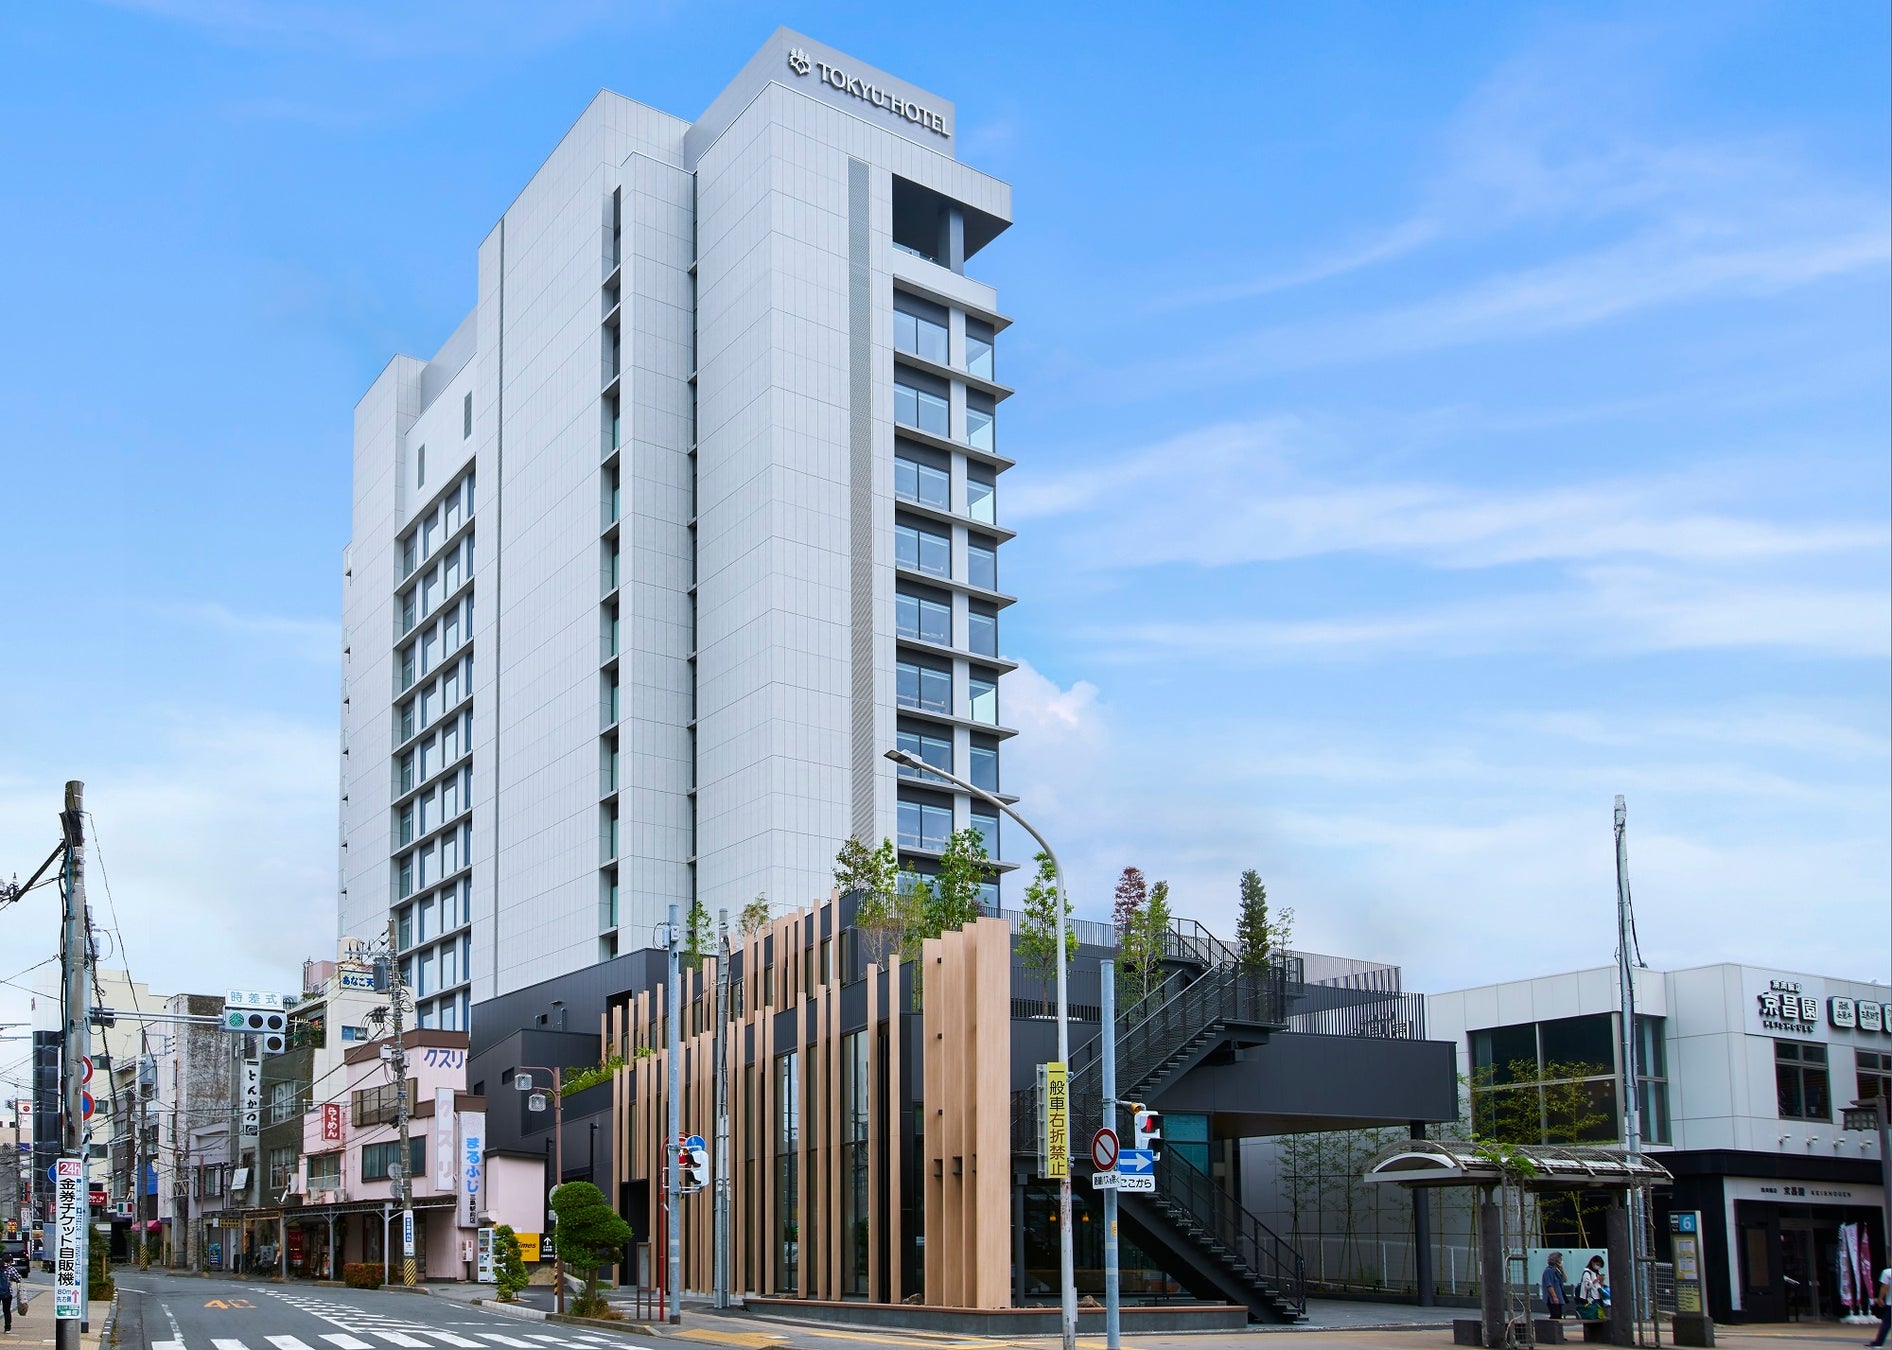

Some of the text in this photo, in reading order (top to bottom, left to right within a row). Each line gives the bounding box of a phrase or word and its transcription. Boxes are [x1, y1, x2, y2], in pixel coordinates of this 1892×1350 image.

[817, 61, 951, 138] TOKYU HOTEL
[230, 991, 278, 1005] 時差式
[1759, 992, 1818, 1021] 京昌園
[424, 1049, 464, 1069] クスリ
[246, 1069, 257, 1122] とんかつ
[438, 1100, 453, 1179] クスリ
[1049, 1069, 1066, 1176] 一般車右折禁止
[60, 1162, 81, 1175] 24h
[465, 1136, 480, 1193] まるふじ
[1120, 1178, 1152, 1188] ここから
[58, 1177, 76, 1287] 金券チケット自販機
[1683, 1216, 1692, 1230] 6
